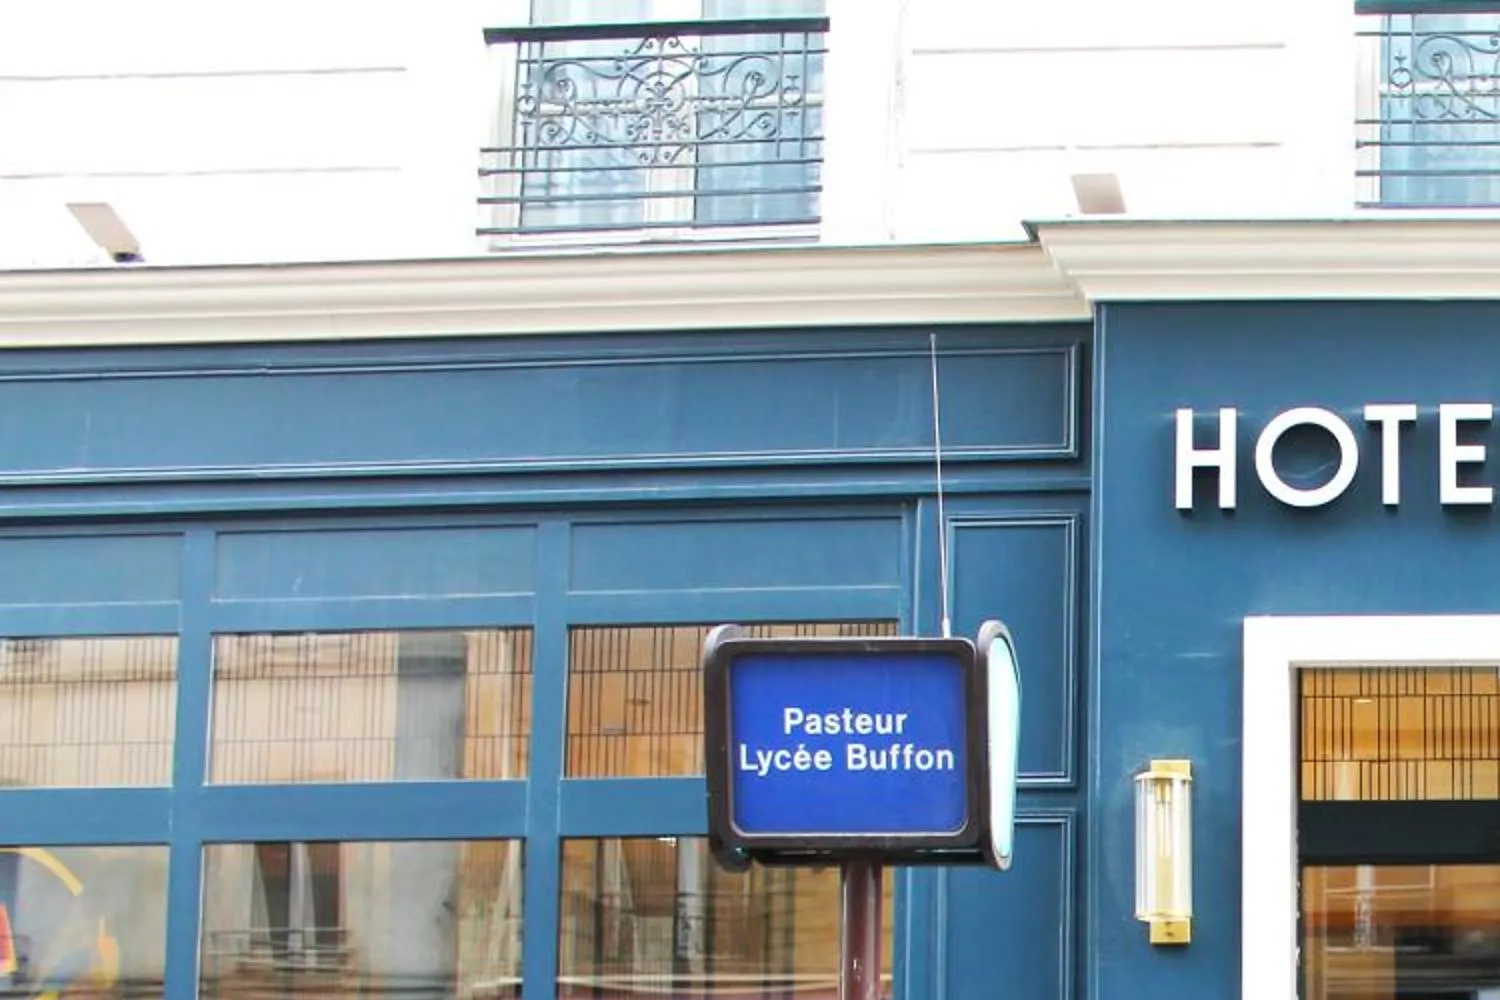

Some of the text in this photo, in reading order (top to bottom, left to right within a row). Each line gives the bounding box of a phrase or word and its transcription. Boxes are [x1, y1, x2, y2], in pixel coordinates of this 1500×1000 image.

[783, 706, 908, 735] Pasteur
[738, 742, 955, 777] Lycée Buffon
